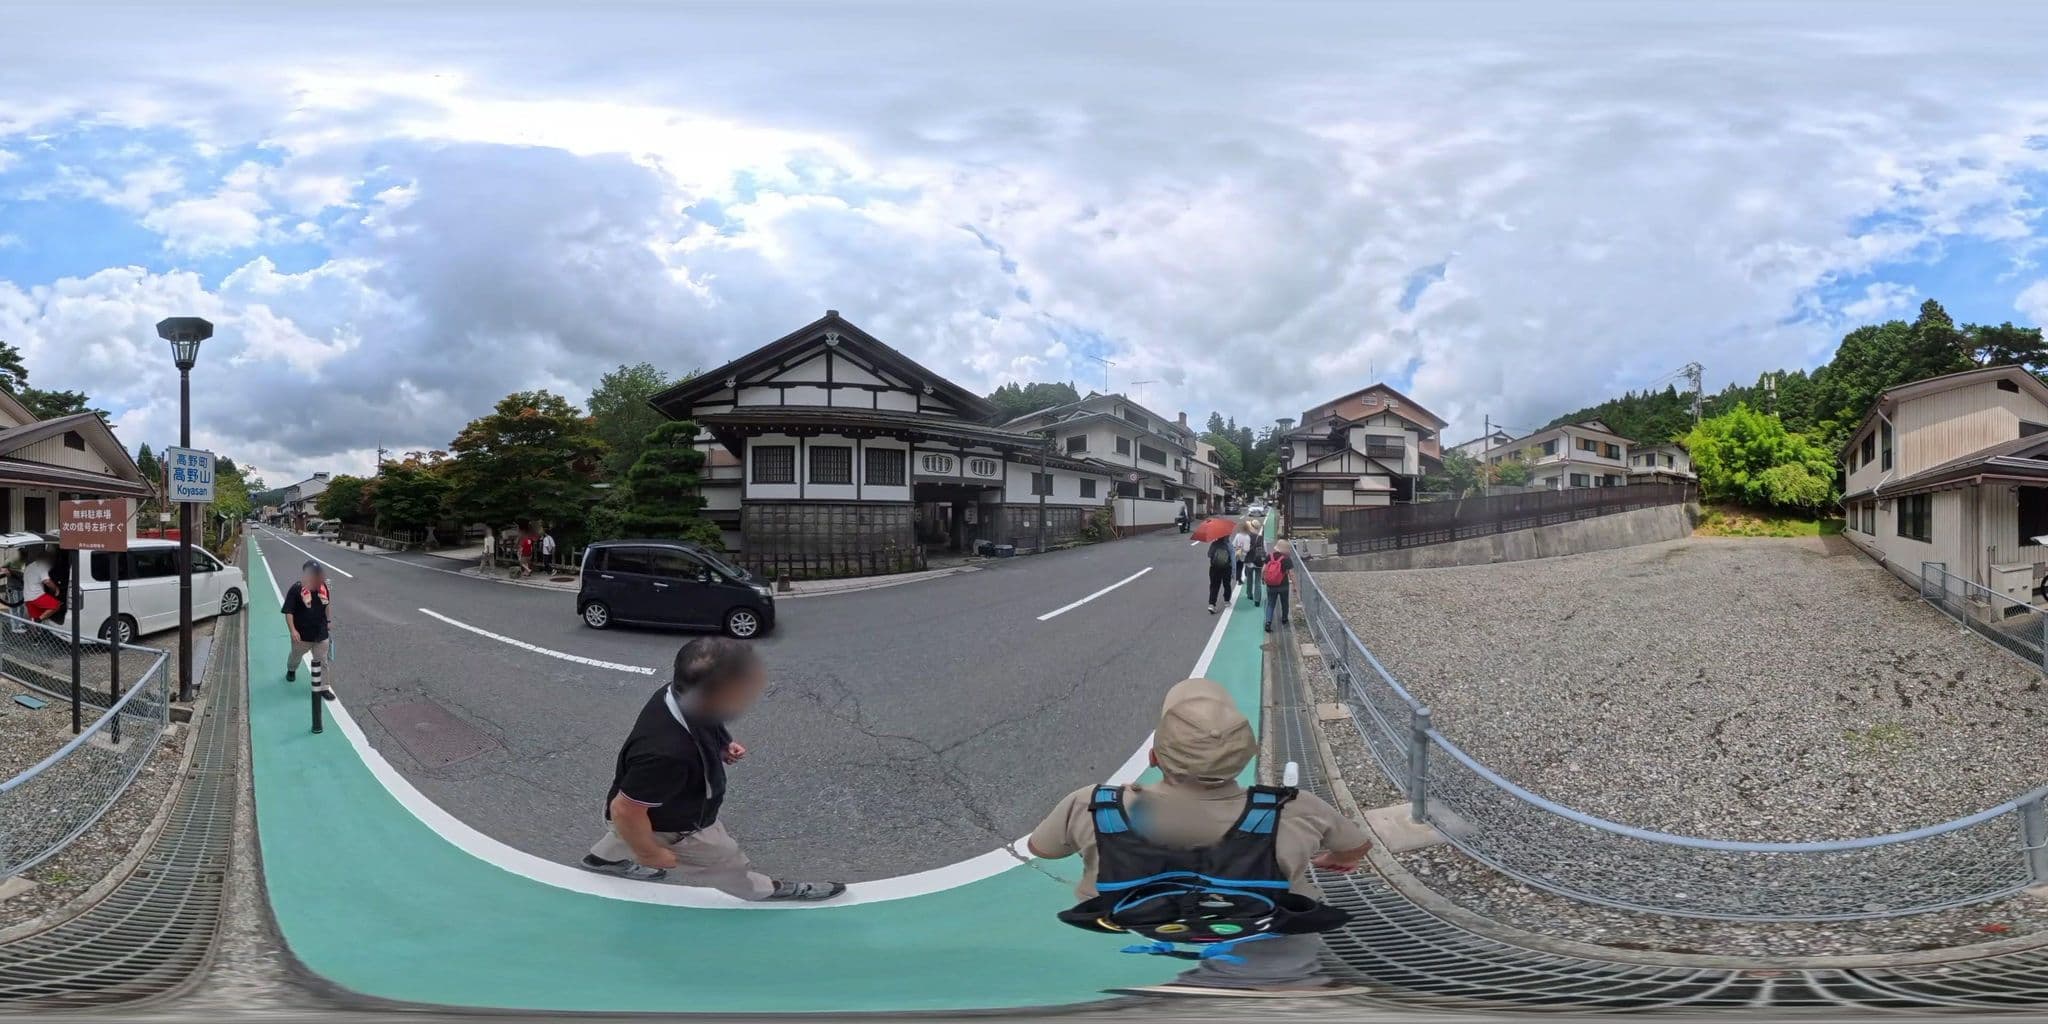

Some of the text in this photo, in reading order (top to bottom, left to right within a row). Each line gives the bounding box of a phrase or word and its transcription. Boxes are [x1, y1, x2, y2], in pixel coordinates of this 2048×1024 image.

[176, 454, 208, 468] 高野町
[173, 467, 210, 483] 高野山
[177, 484, 207, 497] Koyasan
[72, 509, 112, 520] 無料駐車場
[62, 521, 124, 532] 次の信号左折すぐ
